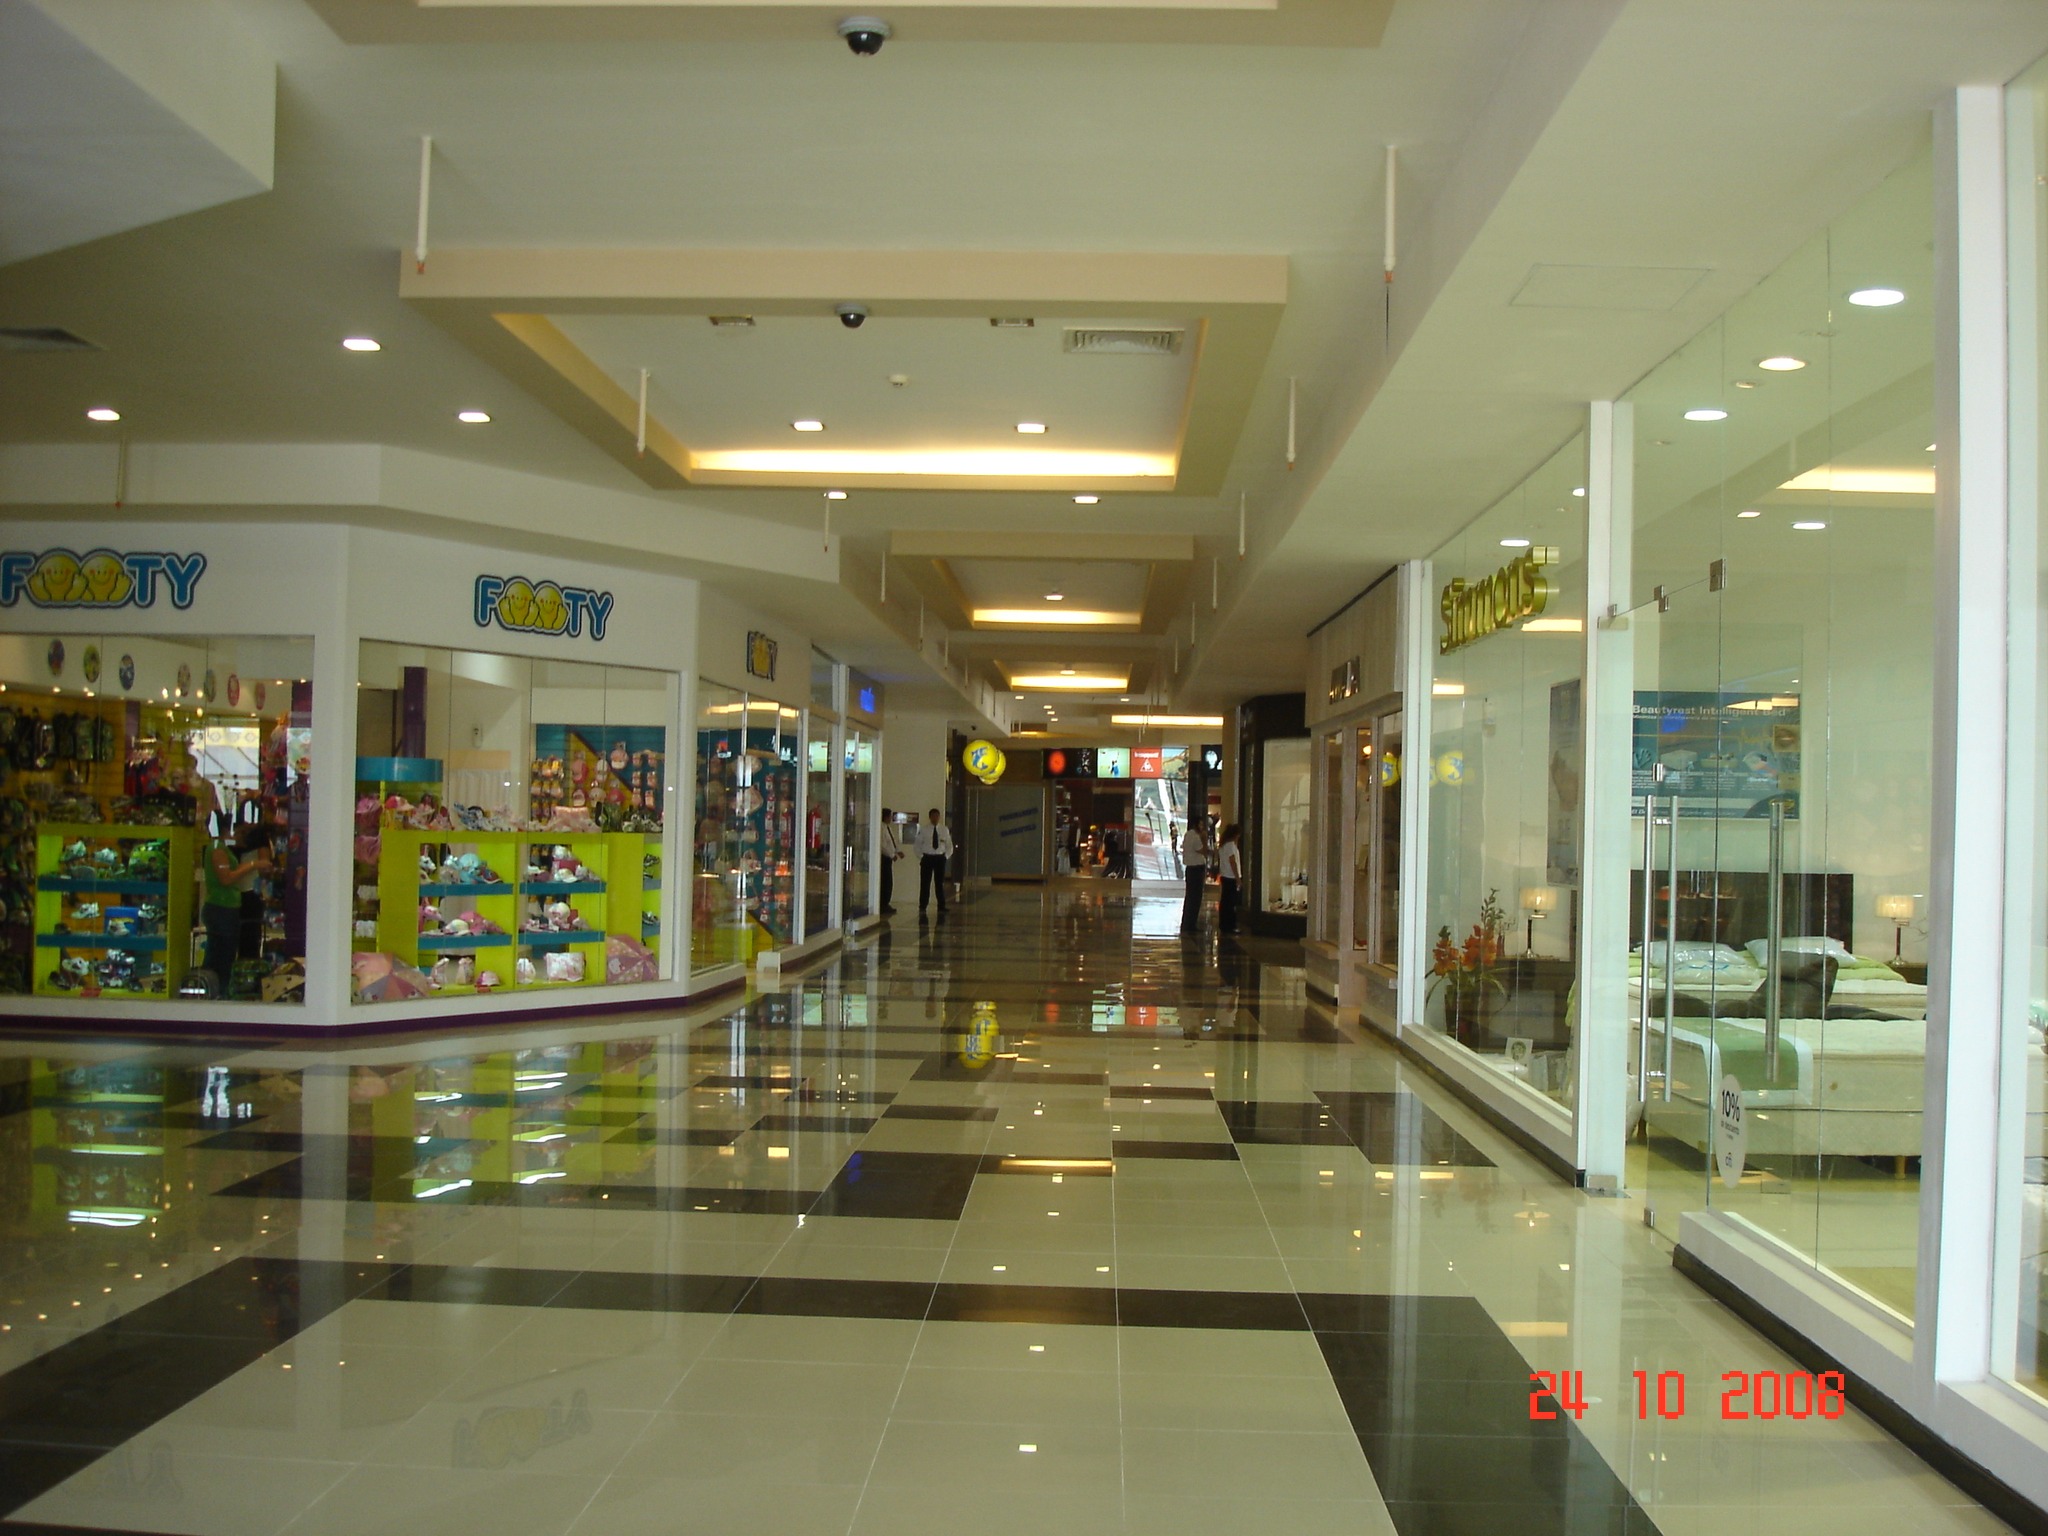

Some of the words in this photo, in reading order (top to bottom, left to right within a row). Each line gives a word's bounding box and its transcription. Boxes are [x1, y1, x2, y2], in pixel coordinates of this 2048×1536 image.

[0, 548, 207, 610] FOOTY
[474, 574, 614, 641] FOOTY
[1633, 705, 1696, 716] Beautyrest
[1700, 706, 1759, 718] Intelligent
[1722, 1089, 1740, 1122] 10%
